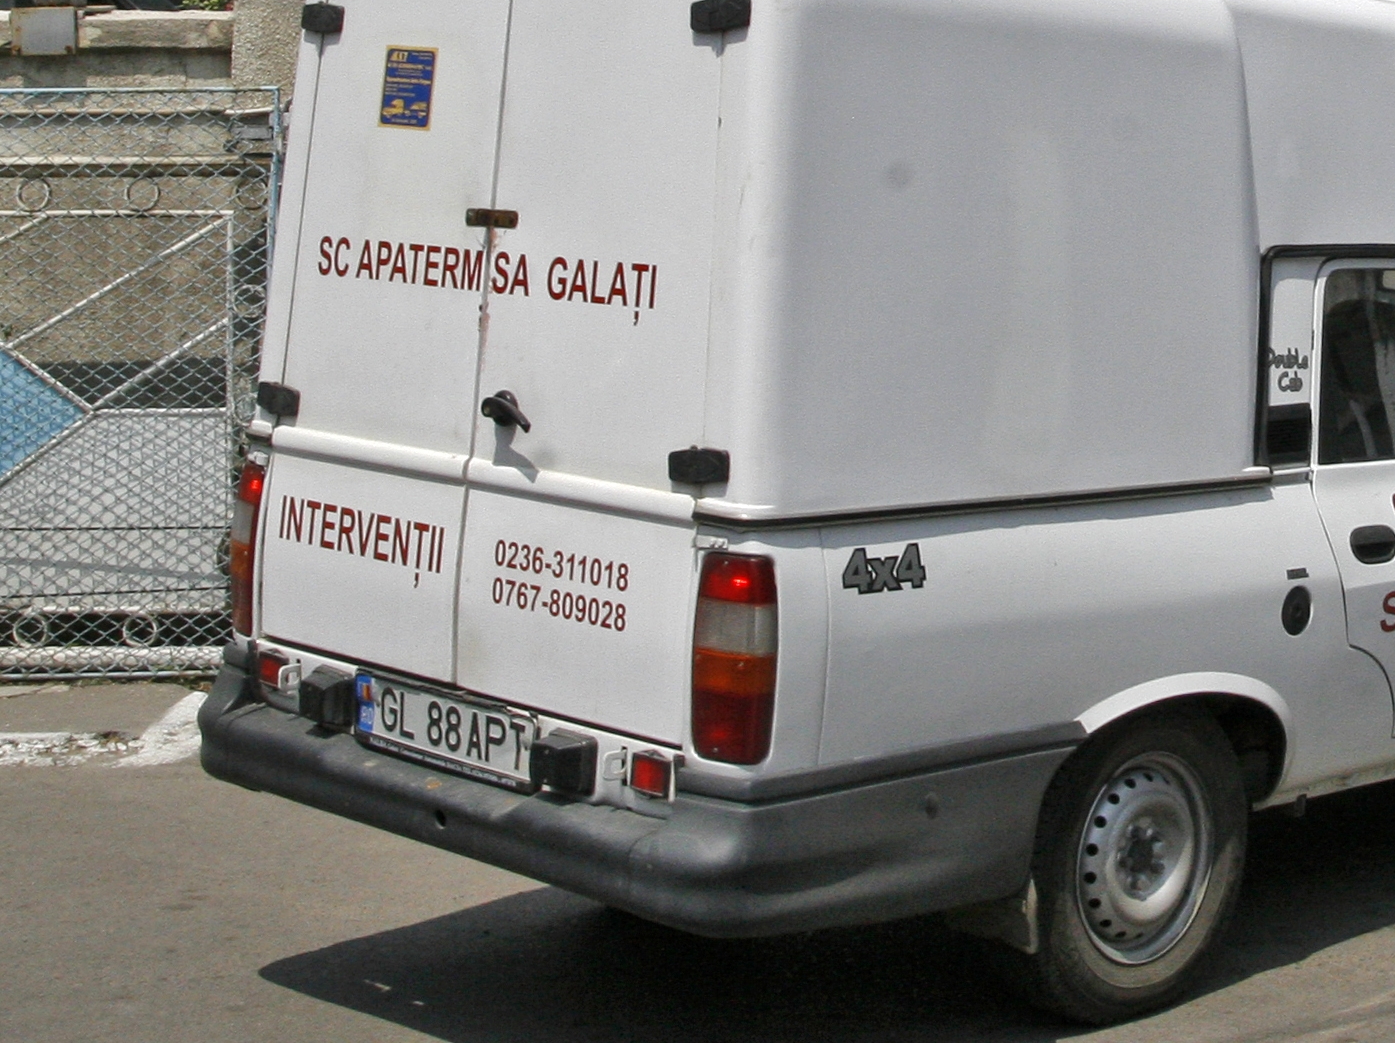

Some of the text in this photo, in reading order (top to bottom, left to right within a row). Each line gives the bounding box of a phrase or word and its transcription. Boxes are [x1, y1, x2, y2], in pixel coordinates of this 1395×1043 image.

[318, 236, 657, 326] SC APATERM SA GALAȚI
[279, 495, 445, 588] INTERVENȚII
[494, 540, 629, 591] 0236-311018
[842, 542, 927, 595] 4x4
[492, 577, 626, 632] 0767-809028
[381, 687, 415, 740] GL
